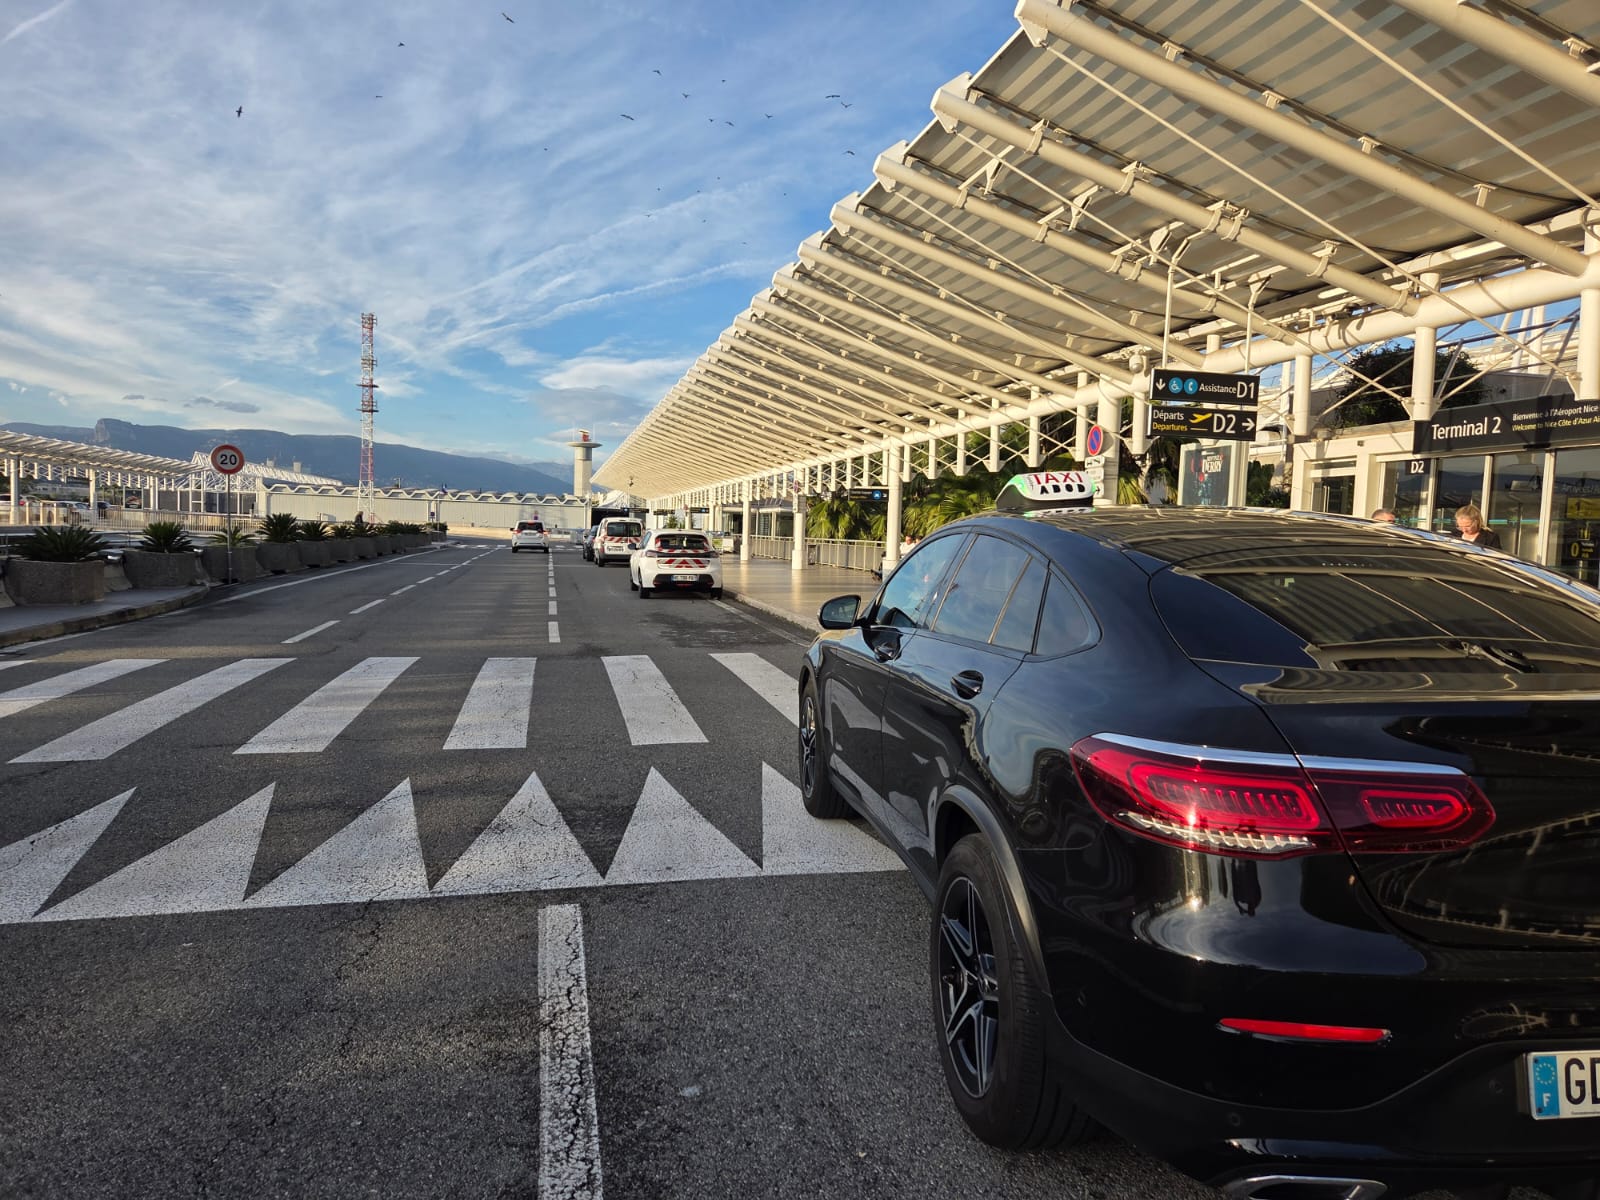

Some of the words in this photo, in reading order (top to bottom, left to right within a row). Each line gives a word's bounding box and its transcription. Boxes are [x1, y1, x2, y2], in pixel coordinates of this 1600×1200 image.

[1199, 384, 1236, 394] Assistance
[1236, 381, 1255, 399] D1
[1583, 404, 1599, 412] Nice
[1153, 410, 1184, 421] Départs
[1153, 422, 1188, 431] Departures
[1213, 413, 1236, 433] D2
[1432, 417, 1488, 440] Terminal
[1491, 416, 1501, 434] 2
[220, 454, 237, 465] 20
[1410, 461, 1424, 473] D2
[1031, 472, 1084, 485] TAXI
[1542, 1092, 1551, 1107] F
